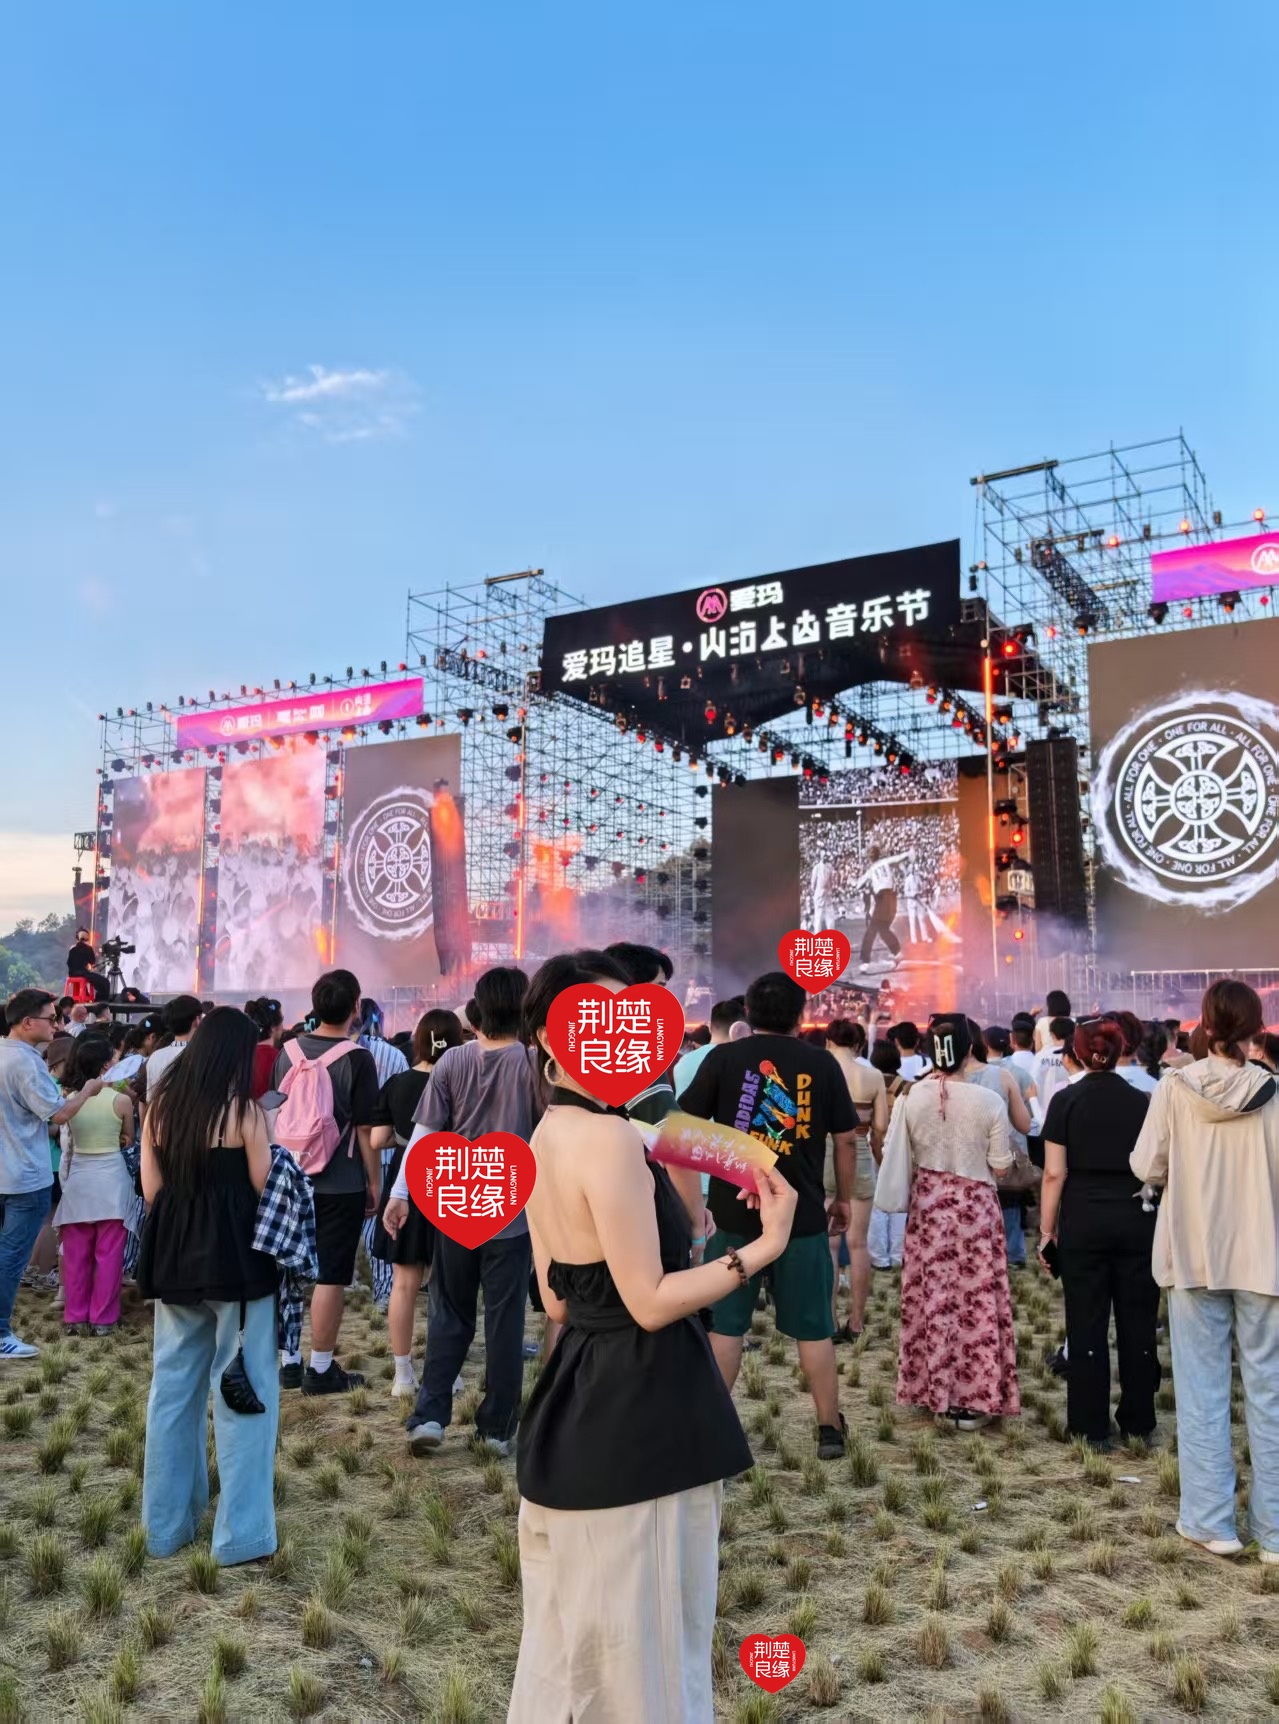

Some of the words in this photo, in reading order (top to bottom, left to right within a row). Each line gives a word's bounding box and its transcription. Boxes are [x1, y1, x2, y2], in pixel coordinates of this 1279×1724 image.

[1164, 725, 1185, 740] ONE
[1187, 721, 1208, 733] FOR
[1209, 723, 1227, 735] ALL
[1138, 740, 1159, 761] ONE
[1234, 732, 1253, 748] ALL
[1250, 744, 1269, 765] FOR
[1263, 764, 1278, 786] ONE
[1126, 761, 1143, 783] FOR
[1124, 785, 1134, 802] ALL
[1266, 795, 1279, 817] ONE
[1125, 810, 1137, 828] ALL
[1256, 818, 1273, 839] FOR
[1131, 828, 1148, 849] FOR
[1241, 837, 1259, 854] ALL
[1145, 845, 1164, 864] ONE
[1217, 854, 1235, 869] ALL
[1172, 860, 1193, 874] ONE
[1195, 863, 1216, 875] FOR
[796, 1074, 812, 1139] DUNK
